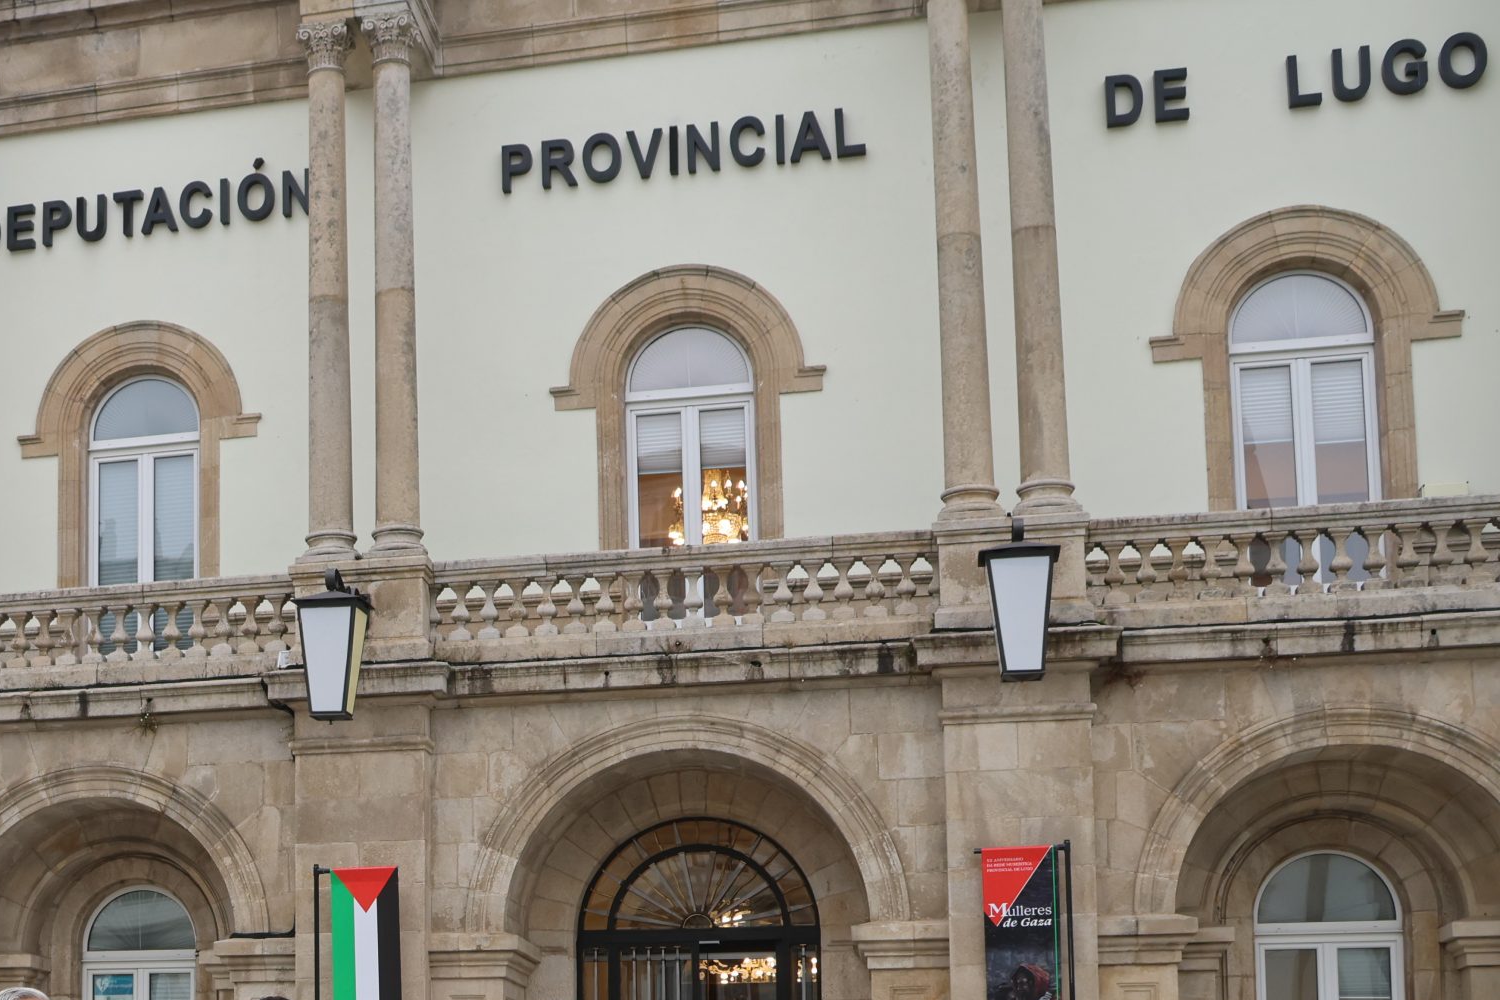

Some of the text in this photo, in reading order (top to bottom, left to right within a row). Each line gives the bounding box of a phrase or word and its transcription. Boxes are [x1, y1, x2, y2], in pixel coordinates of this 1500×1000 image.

[501, 107, 867, 194] PROVINCIAL
[1105, 67, 1190, 129] DE
[1286, 32, 1488, 110] LUGO
[988, 902, 1052, 918] Mulleres
[1002, 917, 1052, 928] de Gaza
